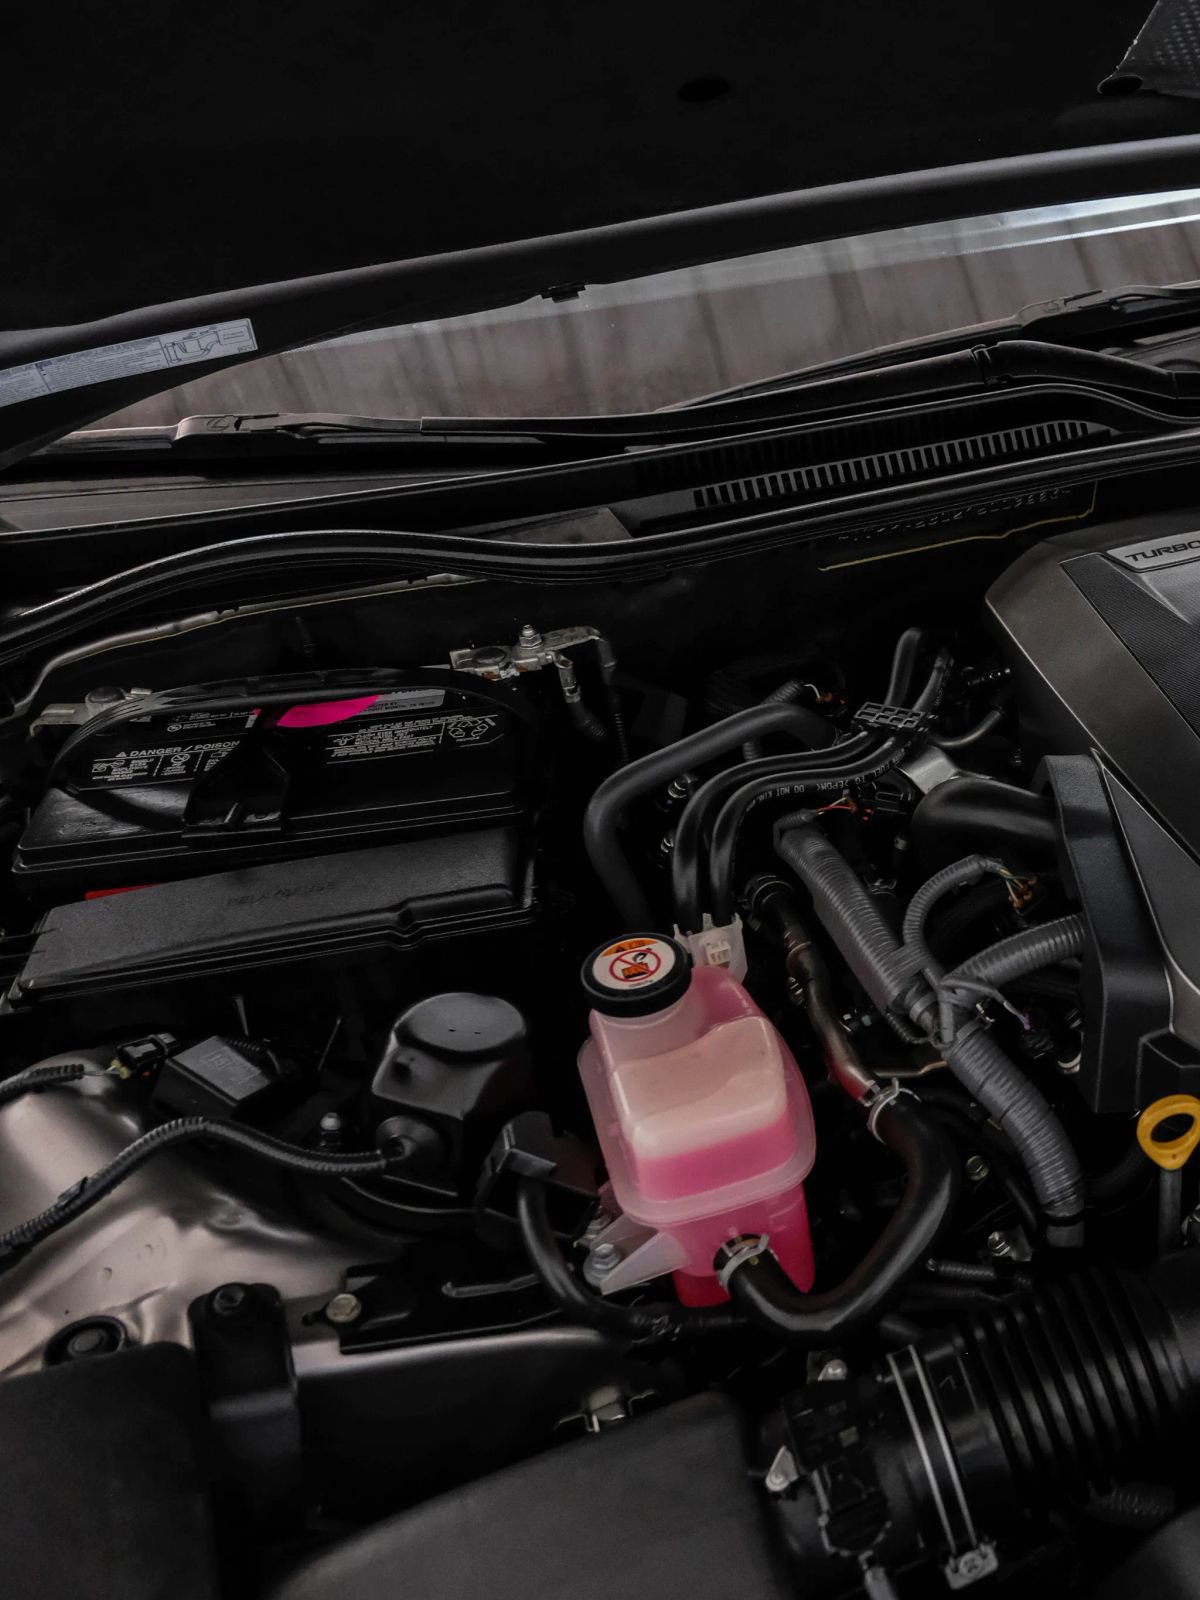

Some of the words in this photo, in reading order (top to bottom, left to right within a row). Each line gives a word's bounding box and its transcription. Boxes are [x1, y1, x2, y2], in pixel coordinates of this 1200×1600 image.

[130, 746, 182, 757] DANGER
[194, 740, 241, 751] POISON
[775, 785, 791, 797] NOT
[793, 784, 805, 794] DO
